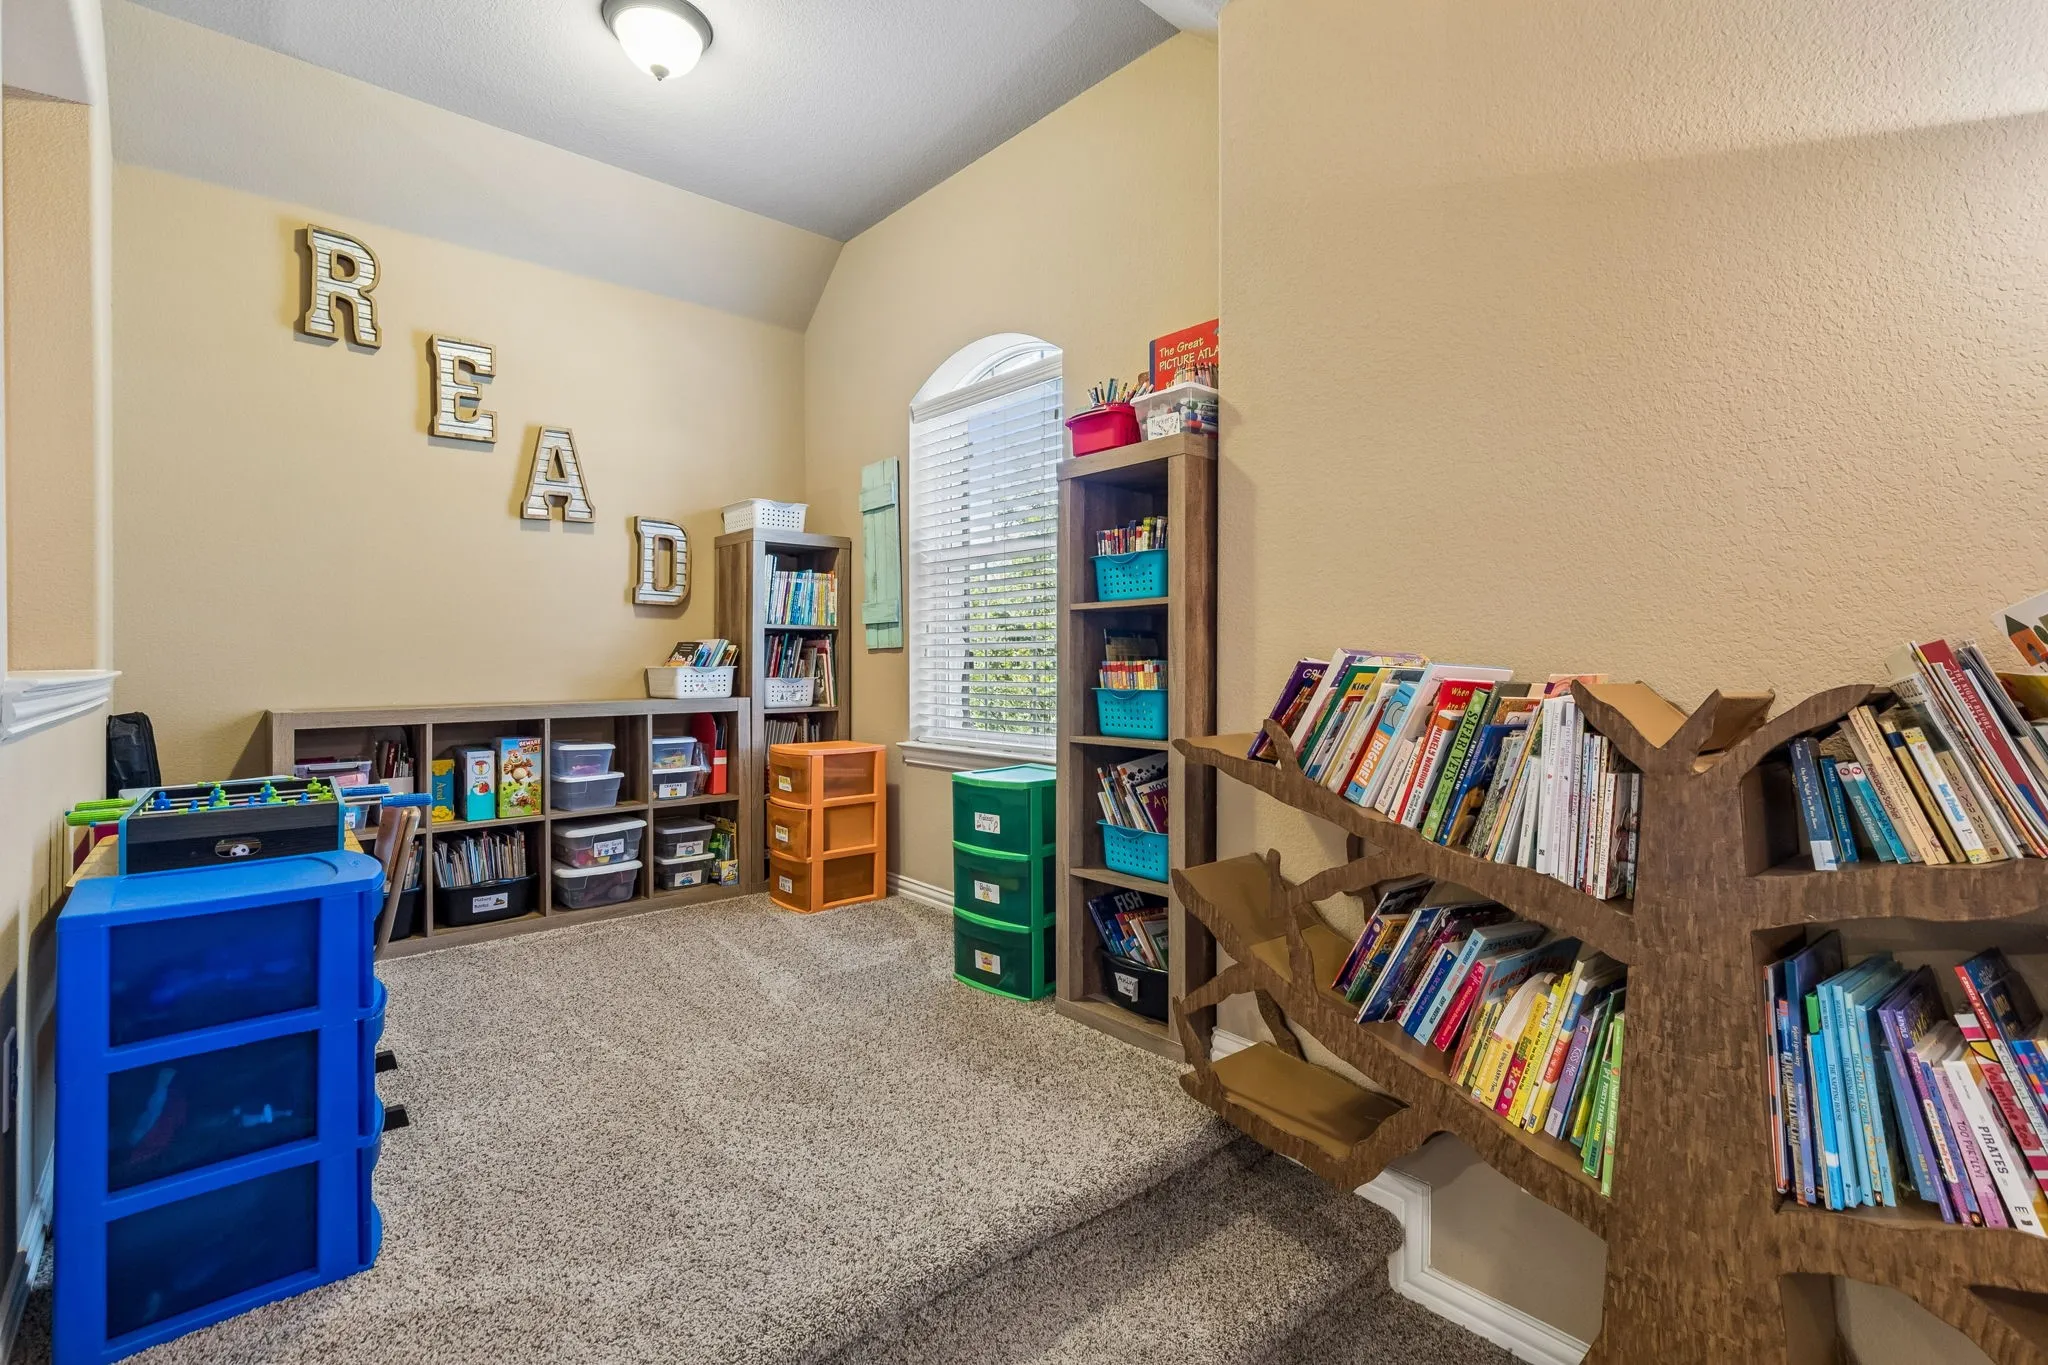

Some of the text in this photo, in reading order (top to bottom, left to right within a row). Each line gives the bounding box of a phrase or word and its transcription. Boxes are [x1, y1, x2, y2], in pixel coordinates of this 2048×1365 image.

[1159, 352, 1195, 371] PICTURE
[1160, 337, 1204, 358] The Great
[1451, 688, 1469, 696] When
[1959, 681, 1978, 704] NIGHT
[1972, 703, 1994, 730] BEFORE
[1454, 709, 1479, 753] SAFARI
[1354, 738, 1386, 785] BIGGIE!
[1416, 755, 1433, 789] WARRIOR
[1443, 753, 1461, 783] VETS
[1865, 762, 1899, 820] Peekaboo Sophie!
[1853, 794, 1880, 842] Forest Friends
[1113, 891, 1145, 912] FISH
[1830, 1075, 1839, 1100] NAPPING
[1608, 1108, 1616, 1125] Easter
[1833, 1101, 1842, 1120] HOUSE
[1983, 1064, 2034, 1148] Valentine Zoo
[1956, 1119, 1970, 1139] TOO
[1977, 1122, 2009, 1176] PIRATES
